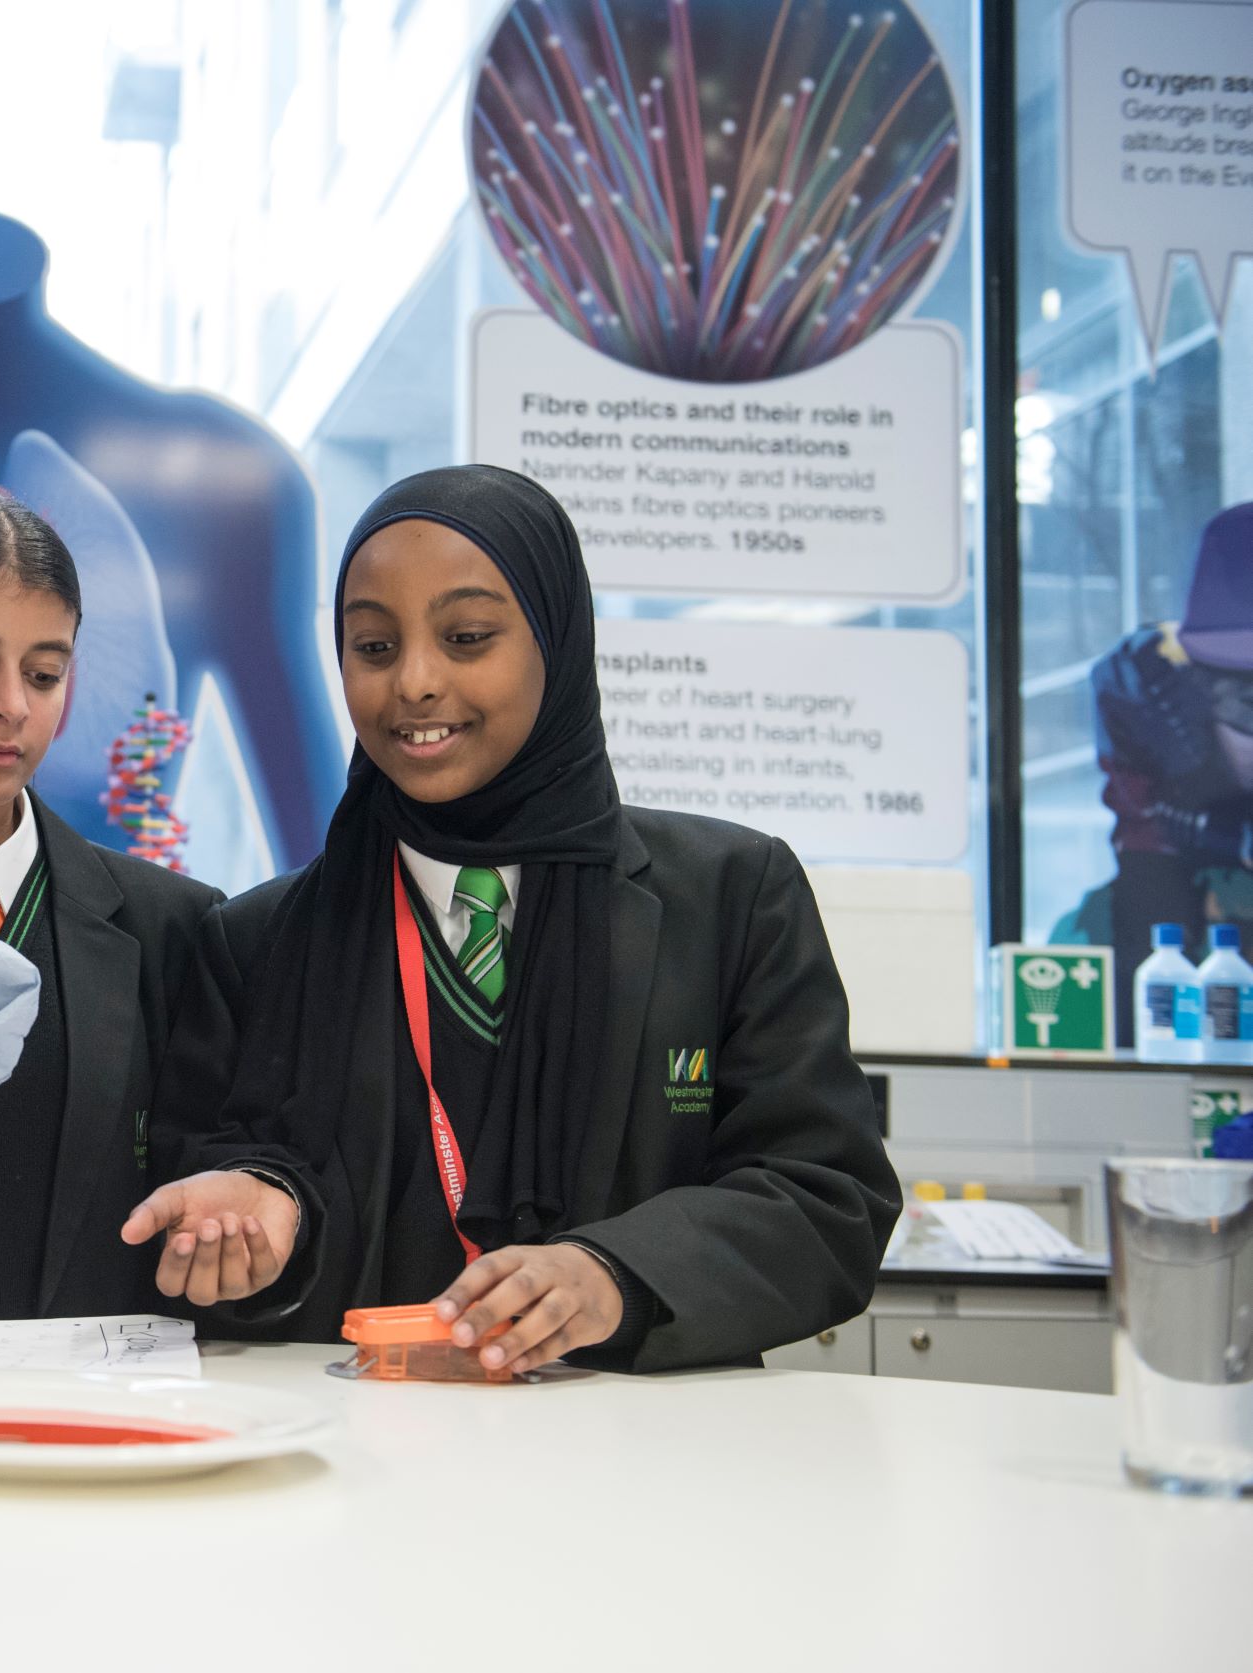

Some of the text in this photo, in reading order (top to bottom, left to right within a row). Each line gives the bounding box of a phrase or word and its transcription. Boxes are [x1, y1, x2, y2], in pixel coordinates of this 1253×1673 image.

[1121, 67, 1215, 96] Oxygen
[1122, 98, 1205, 127] George
[1122, 163, 1135, 182] it
[1143, 167, 1172, 184] on
[1179, 164, 1215, 186] the
[521, 393, 893, 427] Fibre optics and their role in
[521, 428, 850, 458] modern communications
[521, 458, 875, 492] Narinder Kapany and Harold
[632, 493, 686, 515] fibre
[694, 498, 770, 522] optics
[779, 502, 885, 524] pioneers
[732, 530, 805, 553] 1950s
[597, 653, 707, 677] nsplants
[658, 686, 681, 706] of
[691, 688, 754, 708] heart
[762, 692, 855, 718] surgery
[626, 718, 689, 738] heart
[699, 722, 745, 741] and
[754, 722, 883, 752] heart-lung
[610, 750, 724, 779] ecialising
[734, 753, 755, 773] in
[623, 784, 717, 804] domino
[865, 791, 924, 815] 1986
